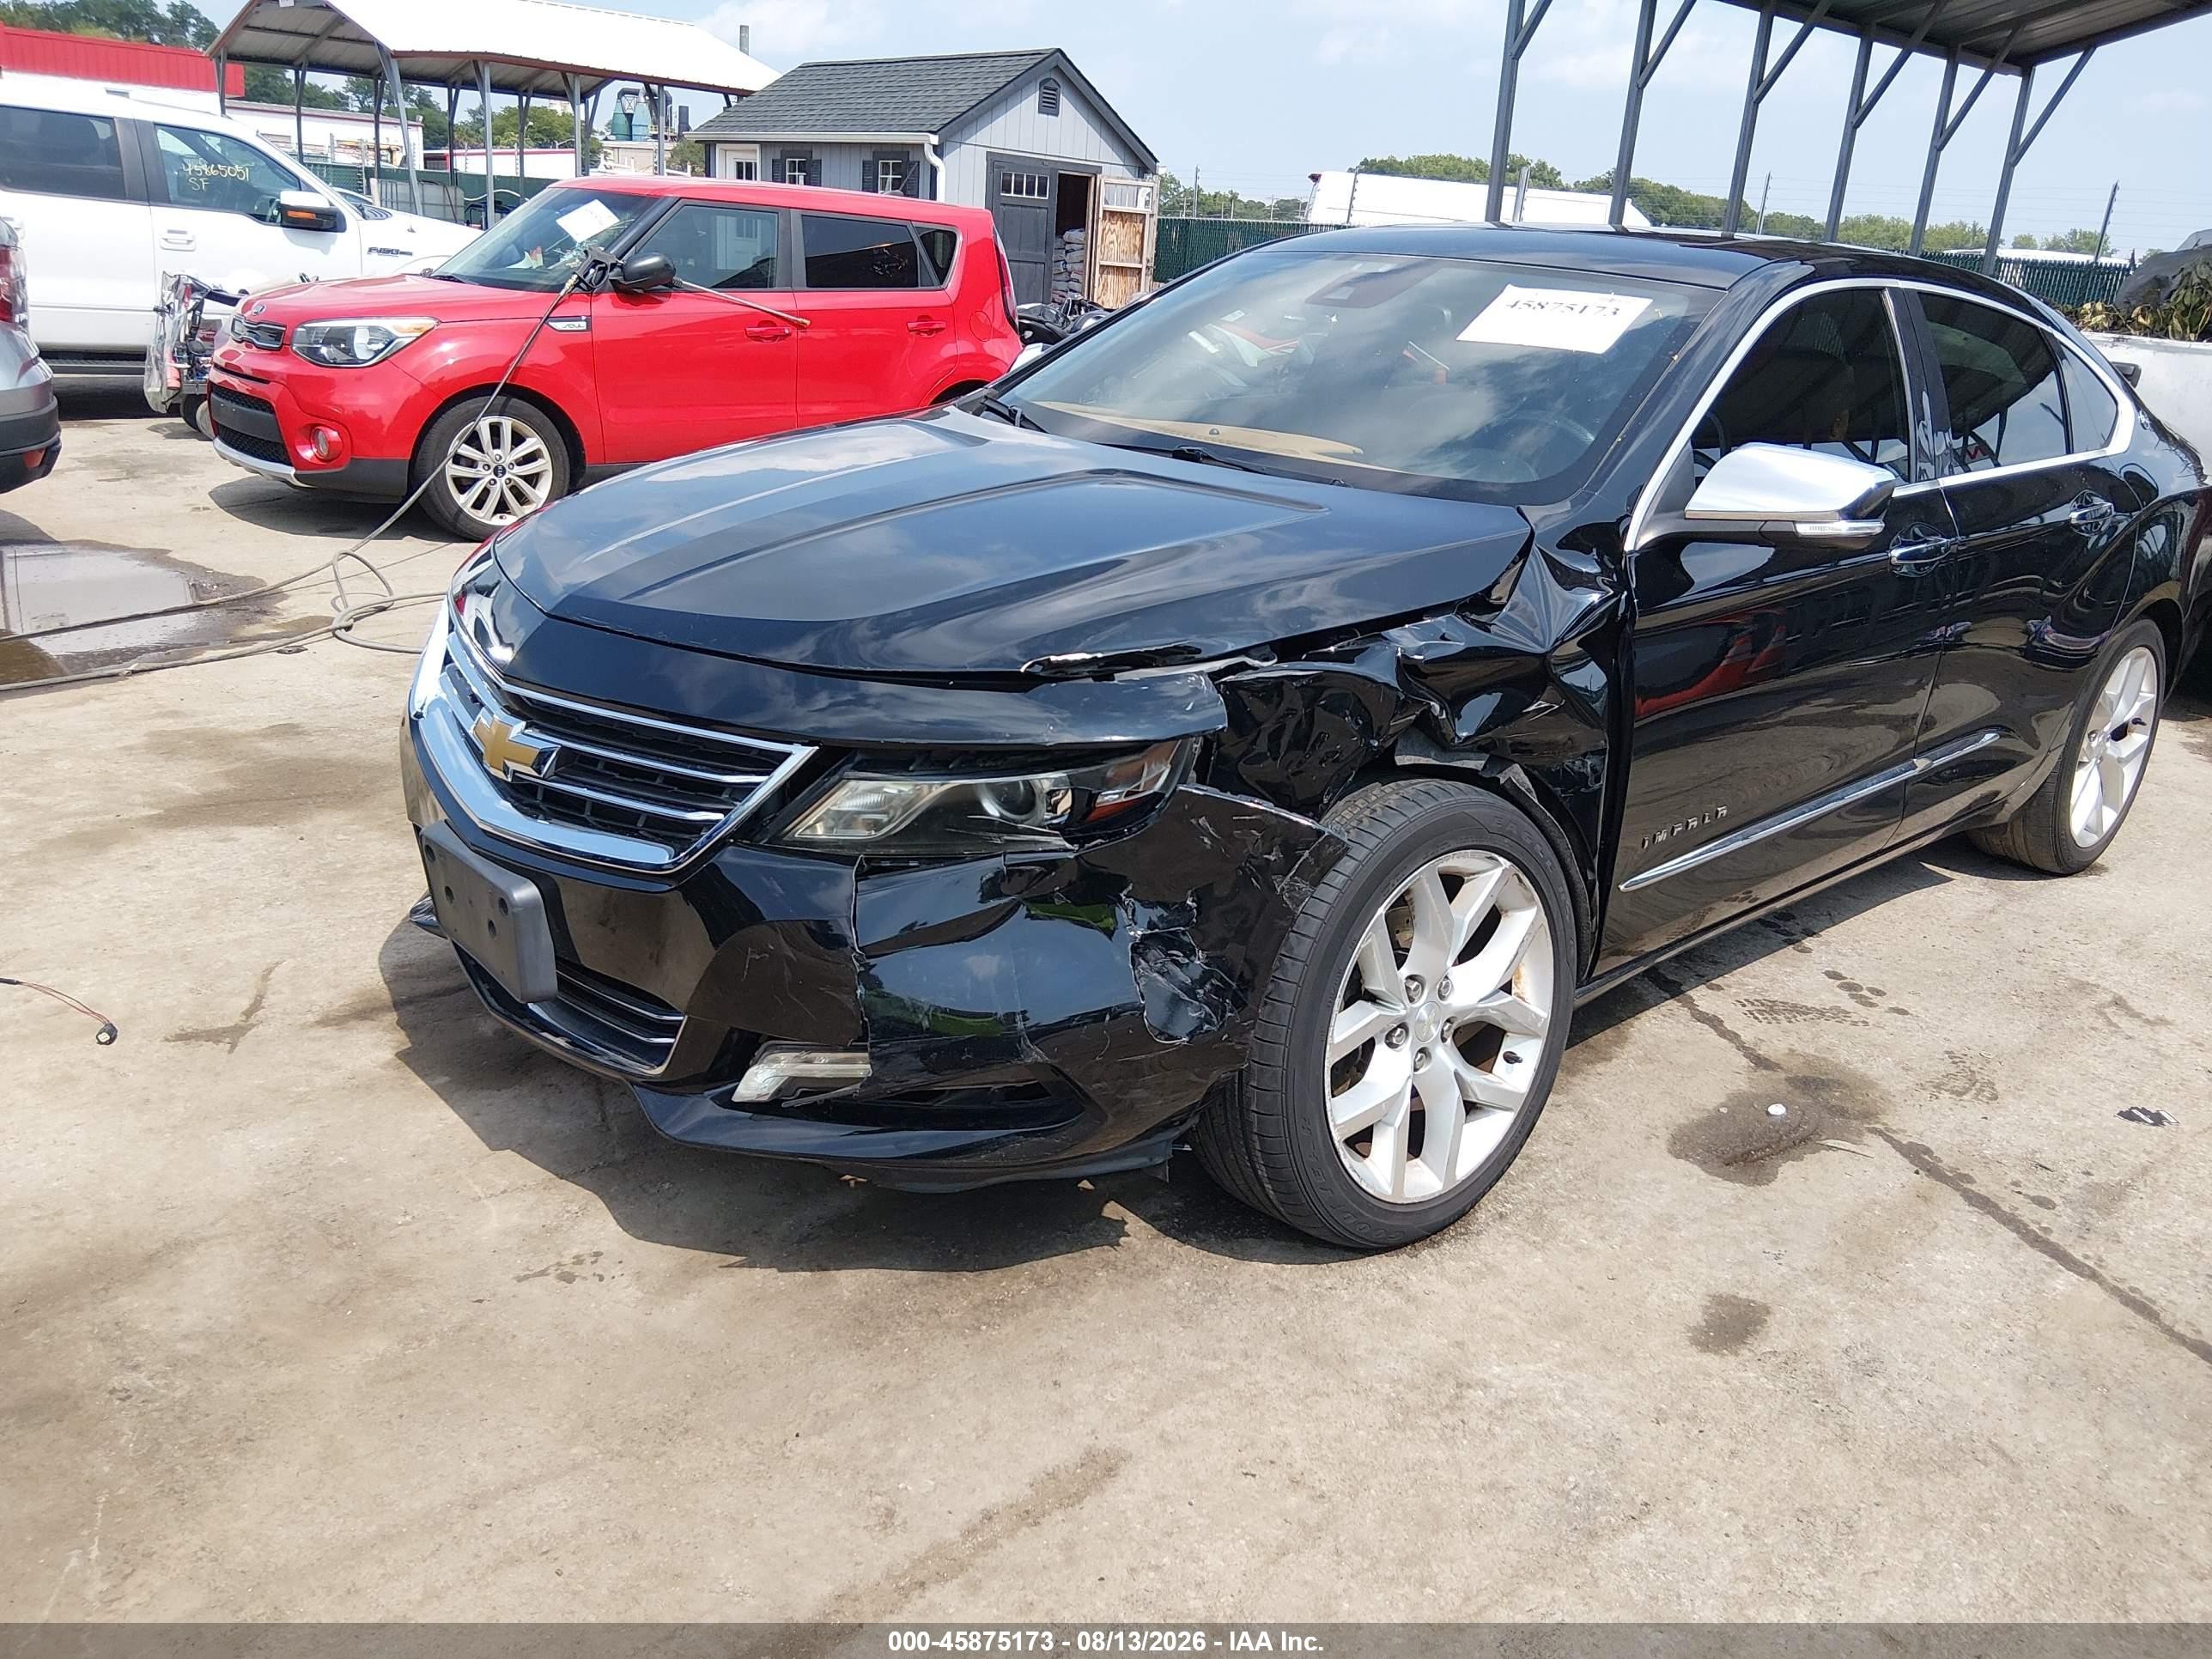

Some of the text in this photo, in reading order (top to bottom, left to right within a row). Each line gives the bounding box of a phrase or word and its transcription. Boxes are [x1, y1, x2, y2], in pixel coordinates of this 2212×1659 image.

[182, 162, 249, 181] 45865051
[188, 177, 210, 191] SF
[1506, 300, 1620, 317] 45875173
[1641, 805, 1728, 850] IMPALA
